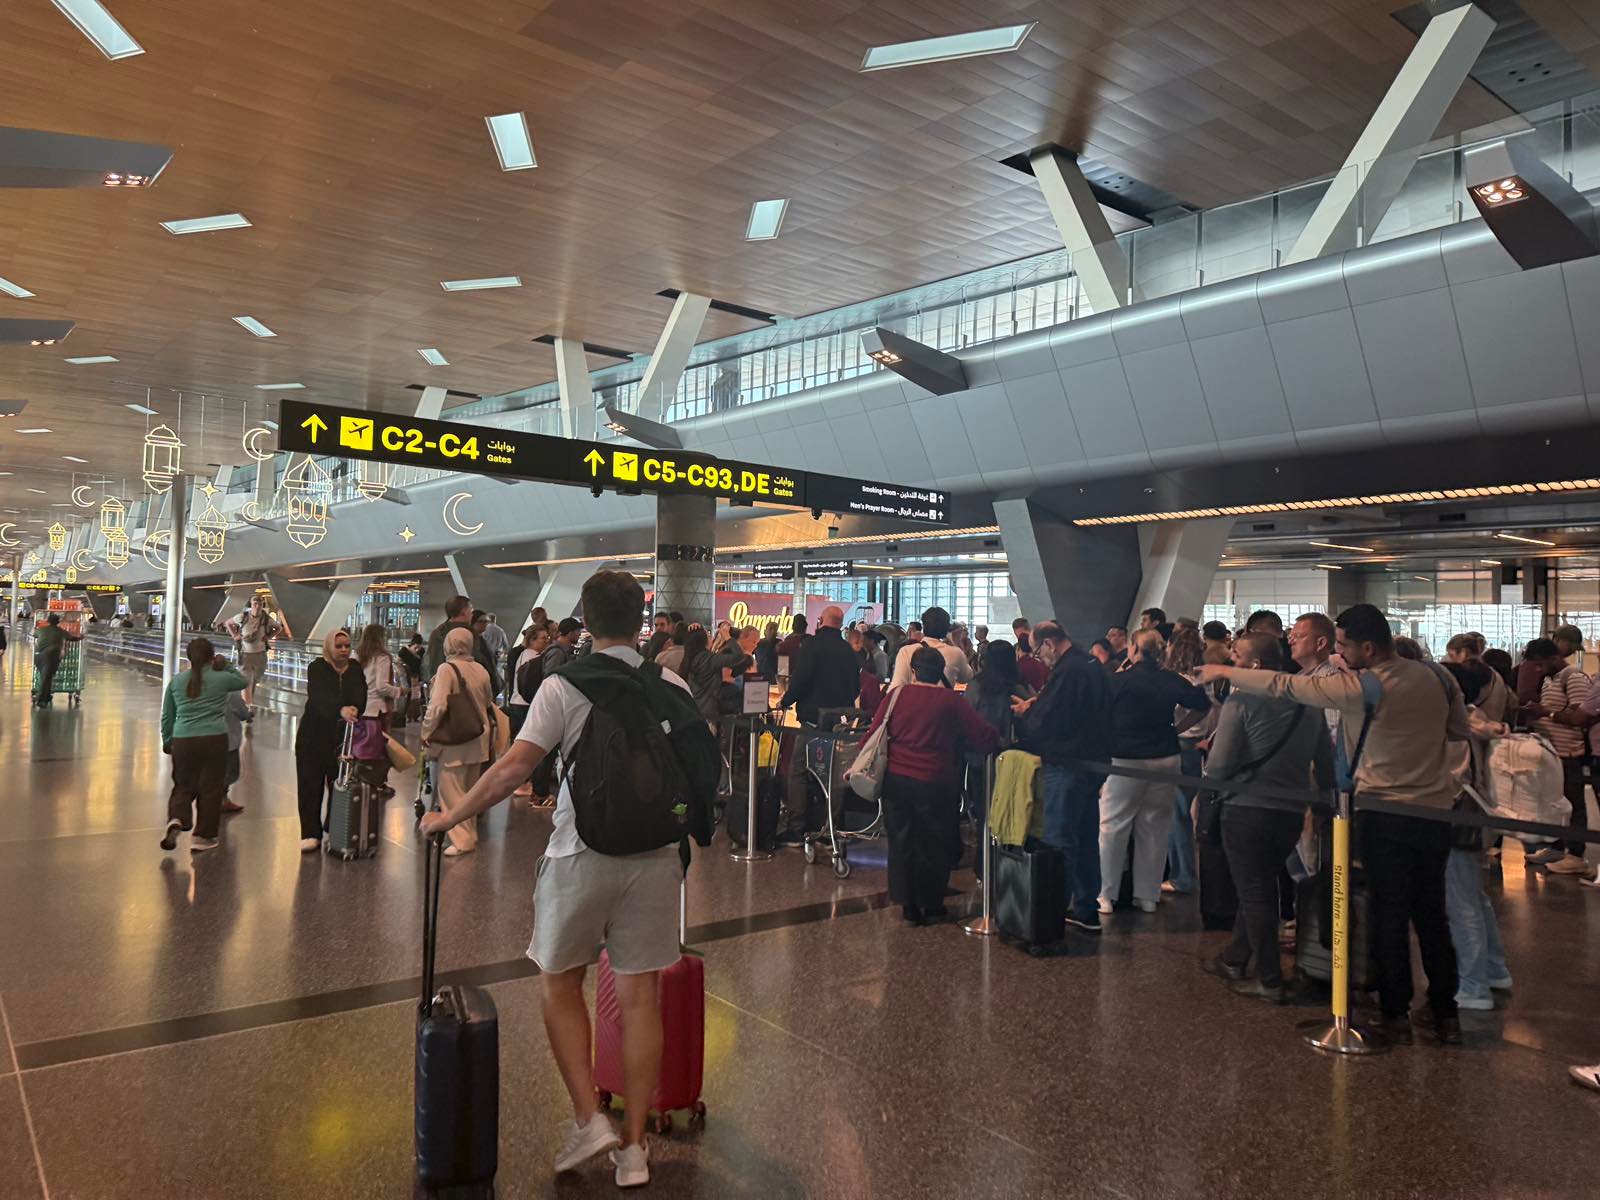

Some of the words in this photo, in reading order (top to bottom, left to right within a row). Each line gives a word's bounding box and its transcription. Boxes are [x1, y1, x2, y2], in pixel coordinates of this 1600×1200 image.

[381, 426, 480, 460] C2-C4
[486, 440, 516, 454] بوابات
[486, 454, 513, 464] Gates
[643, 458, 770, 494] C5-C93,DE
[773, 476, 795, 488] بوابات
[773, 488, 793, 497] Gates
[862, 486, 882, 496] Smoking
[883, 488, 896, 496] Room
[850, 502, 864, 510] Men's
[865, 504, 880, 512] Prayer
[1334, 864, 1344, 895] Stand
